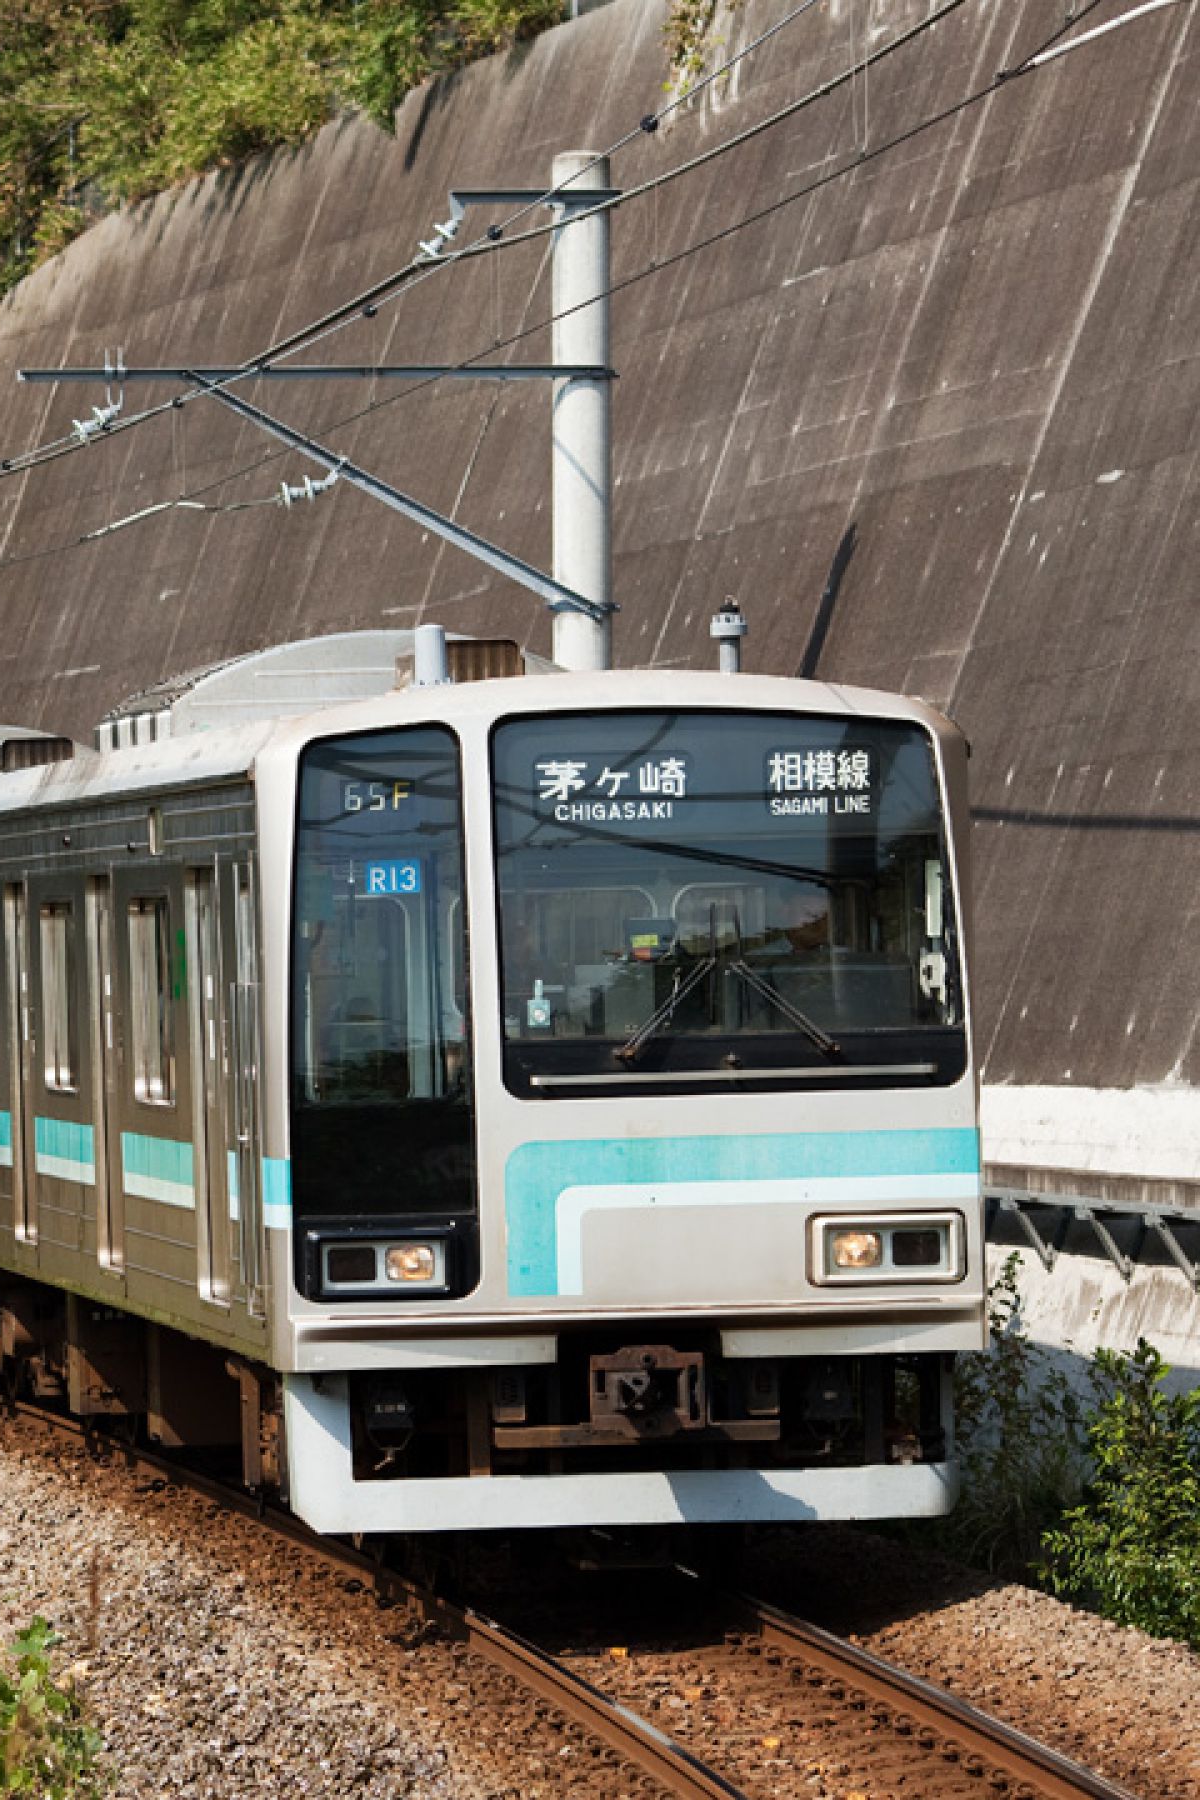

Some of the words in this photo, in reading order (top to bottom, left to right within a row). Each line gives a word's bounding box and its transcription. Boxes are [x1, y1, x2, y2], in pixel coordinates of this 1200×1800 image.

[535, 757, 686, 801] 茅ヶ崎
[768, 749, 871, 793] 相模線
[554, 801, 673, 821] CHIGASAKI
[769, 796, 829, 816] SAGAMI
[834, 794, 871, 814] LINE
[369, 865, 417, 891] R13
